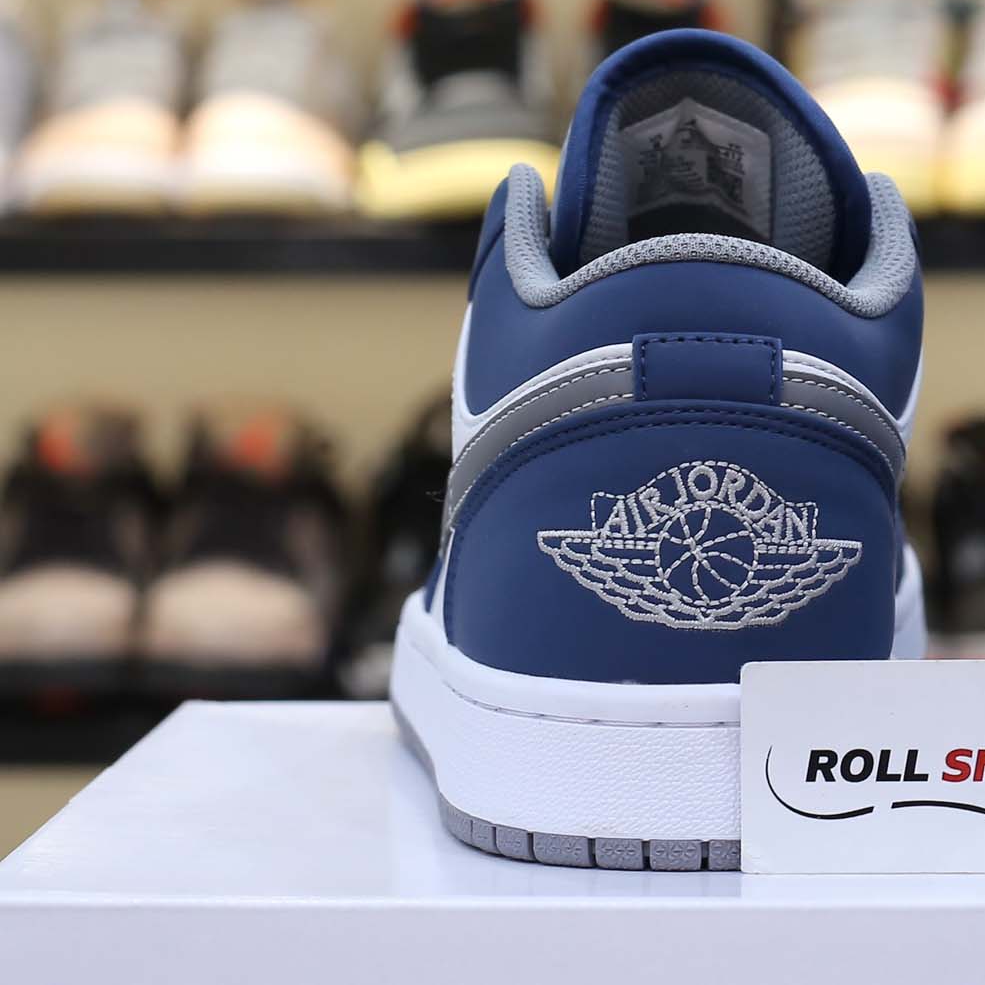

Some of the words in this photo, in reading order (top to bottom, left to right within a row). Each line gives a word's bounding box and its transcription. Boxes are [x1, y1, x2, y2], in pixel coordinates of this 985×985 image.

[602, 487, 681, 536] AIR
[672, 466, 815, 543] JORDAN
[805, 749, 929, 783] ROLL
